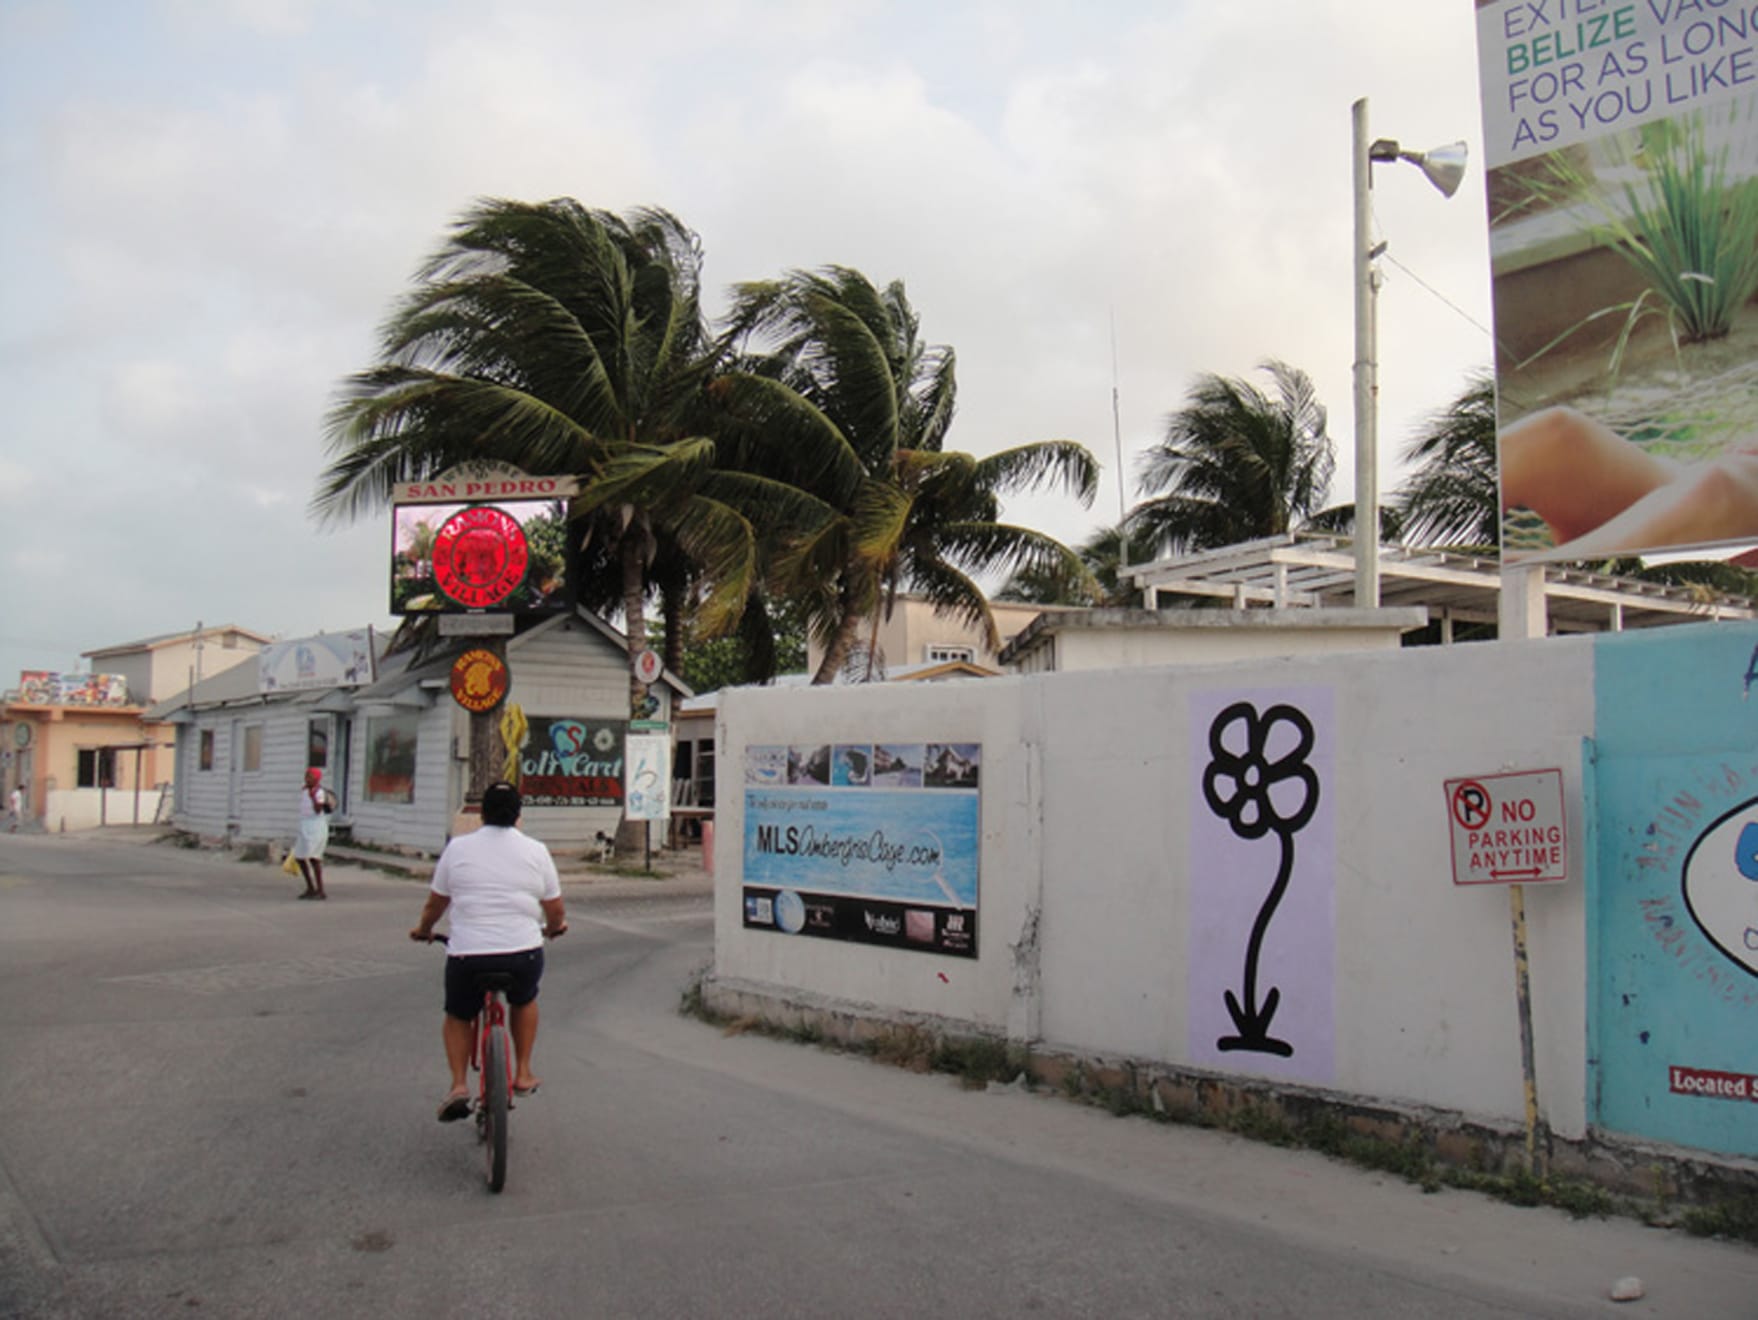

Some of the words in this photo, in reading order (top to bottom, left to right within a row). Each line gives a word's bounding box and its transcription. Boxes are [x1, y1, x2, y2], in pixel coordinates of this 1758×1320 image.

[1507, 5, 1637, 75] BELIZE
[1509, 63, 1585, 112] FOR
[1598, 42, 1648, 86] AS
[1512, 110, 1560, 151] AS
[1570, 80, 1652, 130] YOU
[1666, 47, 1756, 104] LIKE
[407, 484, 456, 499] SAN
[466, 479, 556, 496] PEDRO
[441, 569, 520, 604] VILLAGE
[571, 753, 623, 778] Cart
[1501, 799, 1536, 824] NO
[1468, 825, 1561, 849] PARKING
[1470, 845, 1561, 870] ANYTIME
[1674, 1069, 1747, 1097] Located
